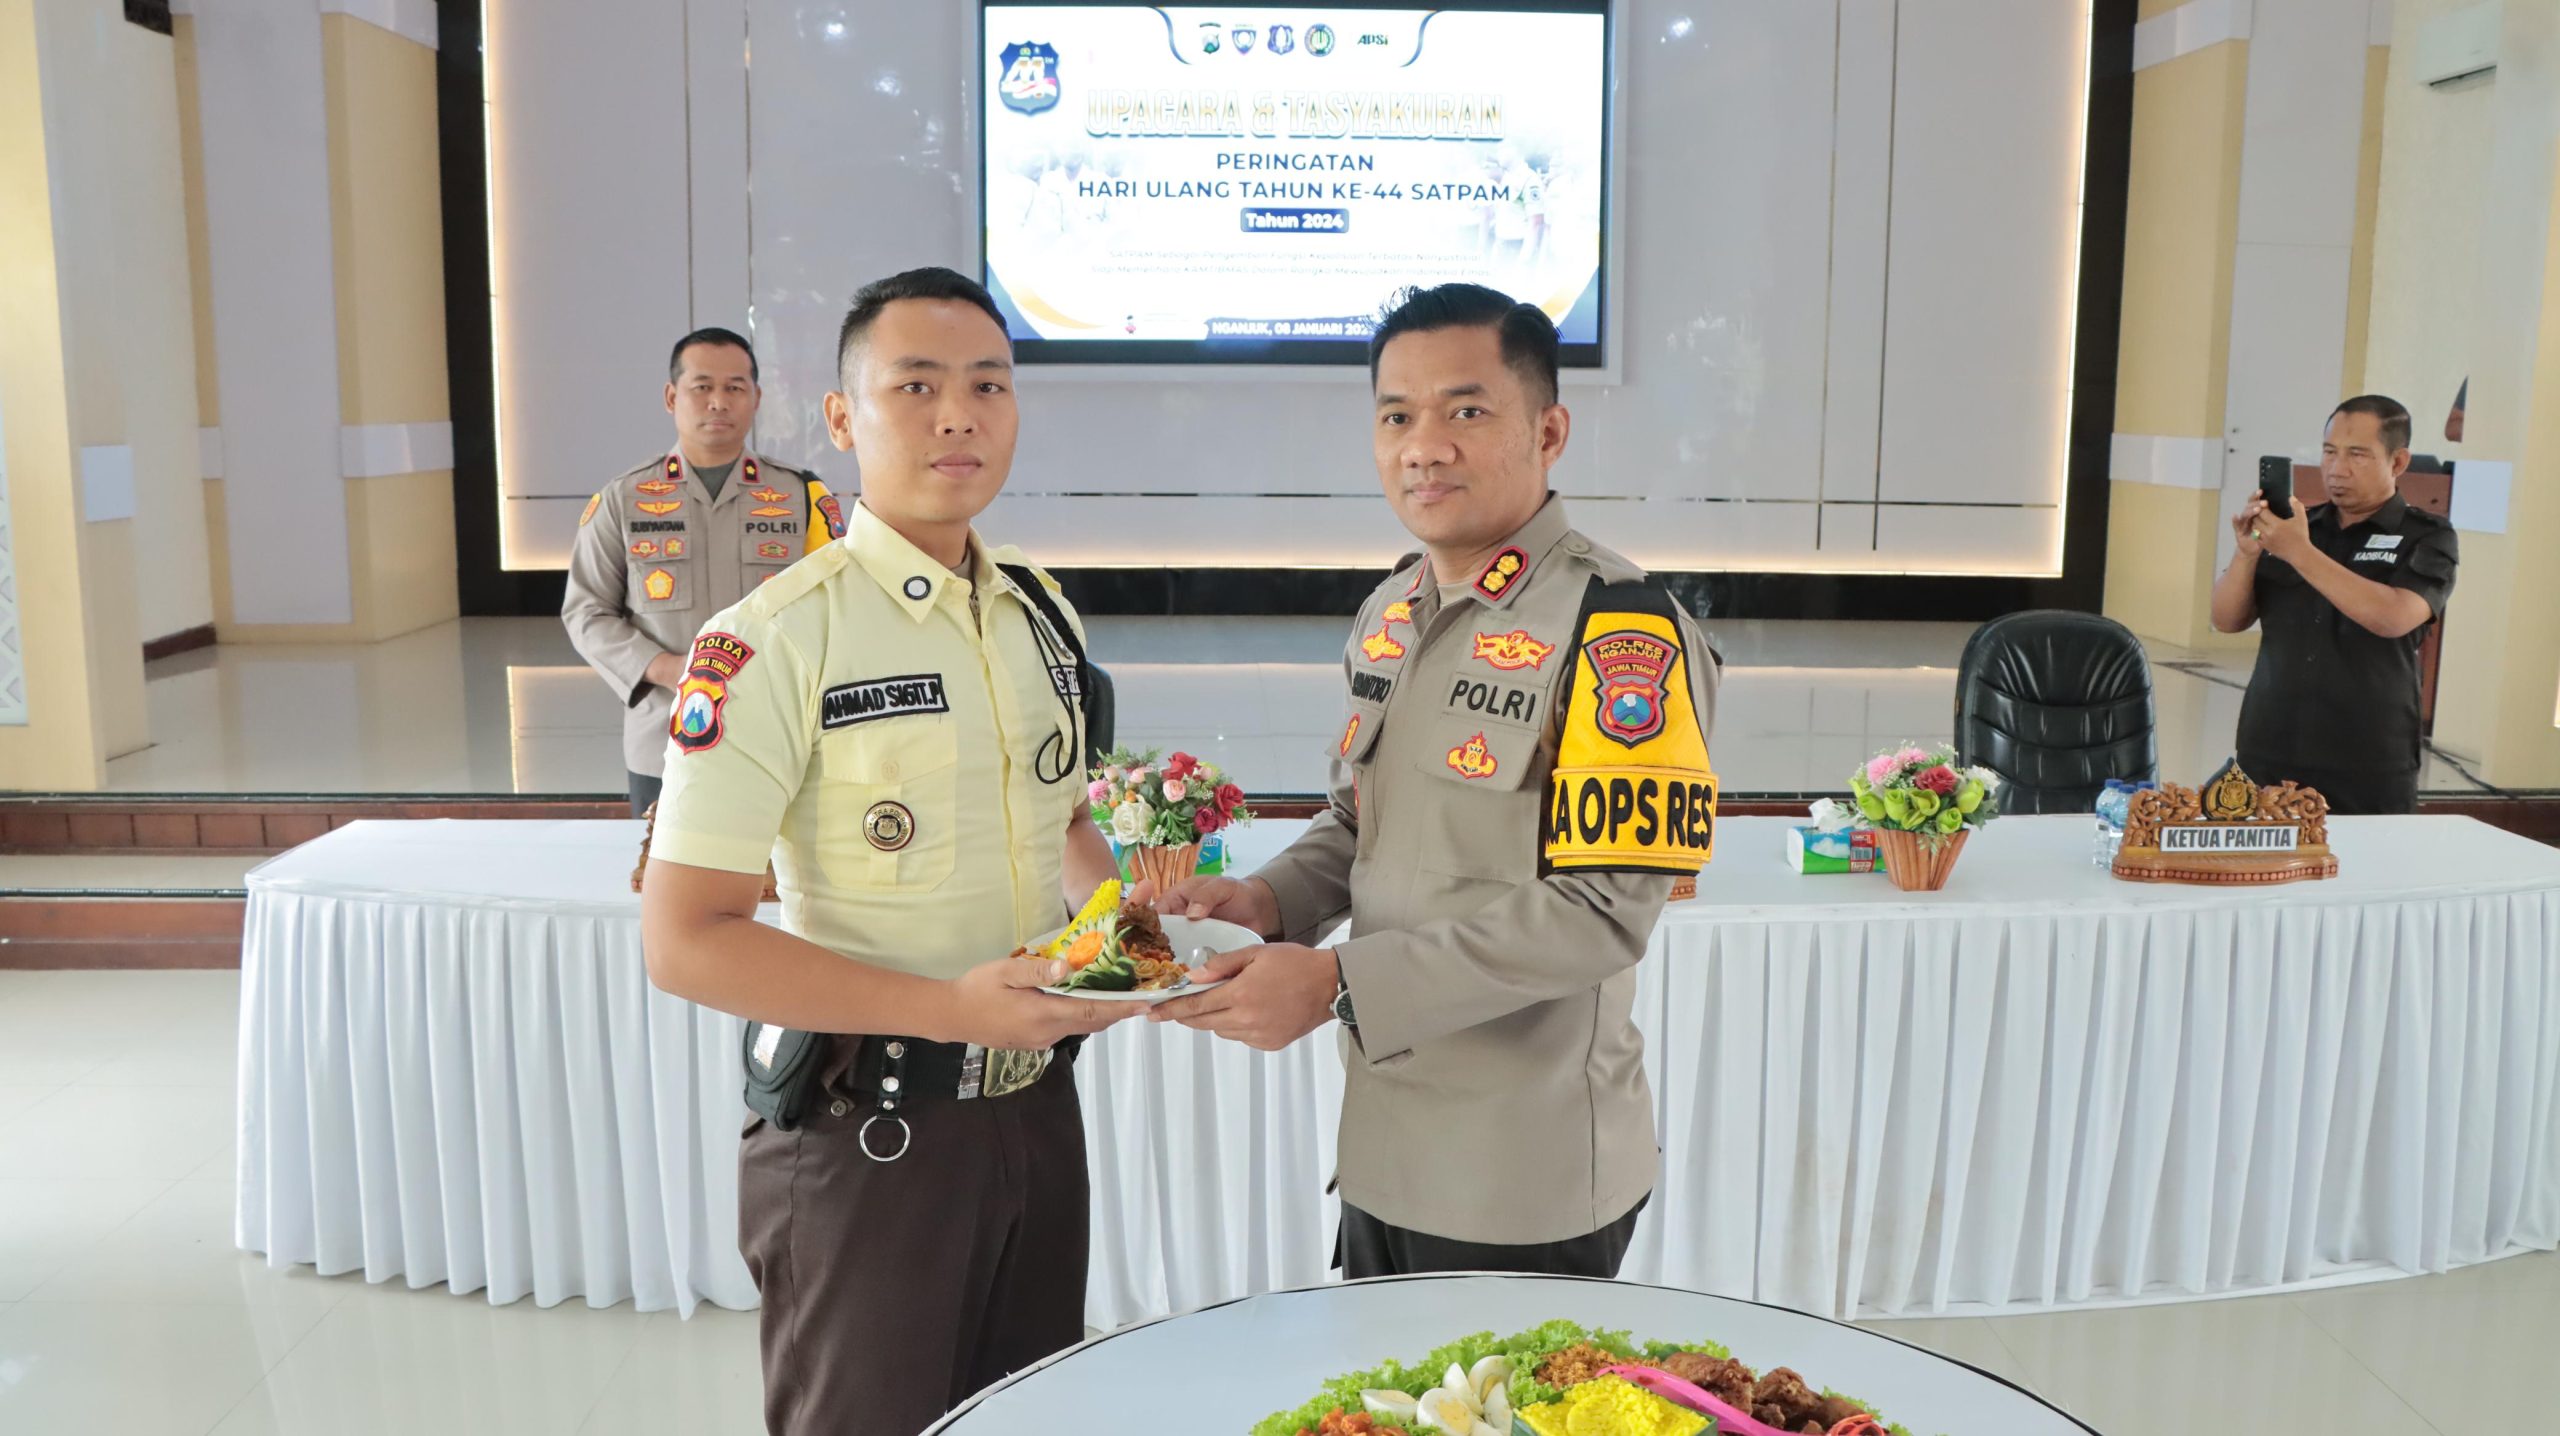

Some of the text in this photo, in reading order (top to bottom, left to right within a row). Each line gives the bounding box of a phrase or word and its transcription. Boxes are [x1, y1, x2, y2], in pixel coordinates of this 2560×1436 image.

[1086, 88, 1505, 141] UPACARA & TASYAKURAN
[1216, 153, 1374, 171] PERINGATAN
[1079, 181, 1510, 201] HARI ULANG TAHUN KE-44 SATPAM
[1245, 212, 1345, 229] Tahun 2024
[1292, 322, 1343, 336] JANUARI
[745, 522, 798, 534] POLRI
[697, 637, 743, 660] POLDA
[1598, 640, 1664, 655] POLRES
[1599, 647, 1663, 662] NGANJUK
[711, 659, 733, 676] TIMUR
[1606, 663, 1658, 677] JAWA TIMUR
[825, 687, 886, 720] AHMAD
[1449, 680, 1536, 723] POLRI
[1577, 777, 1659, 846] OPS
[1667, 780, 1713, 851] RES
[2166, 828, 2291, 848] KETUA PANITIA
